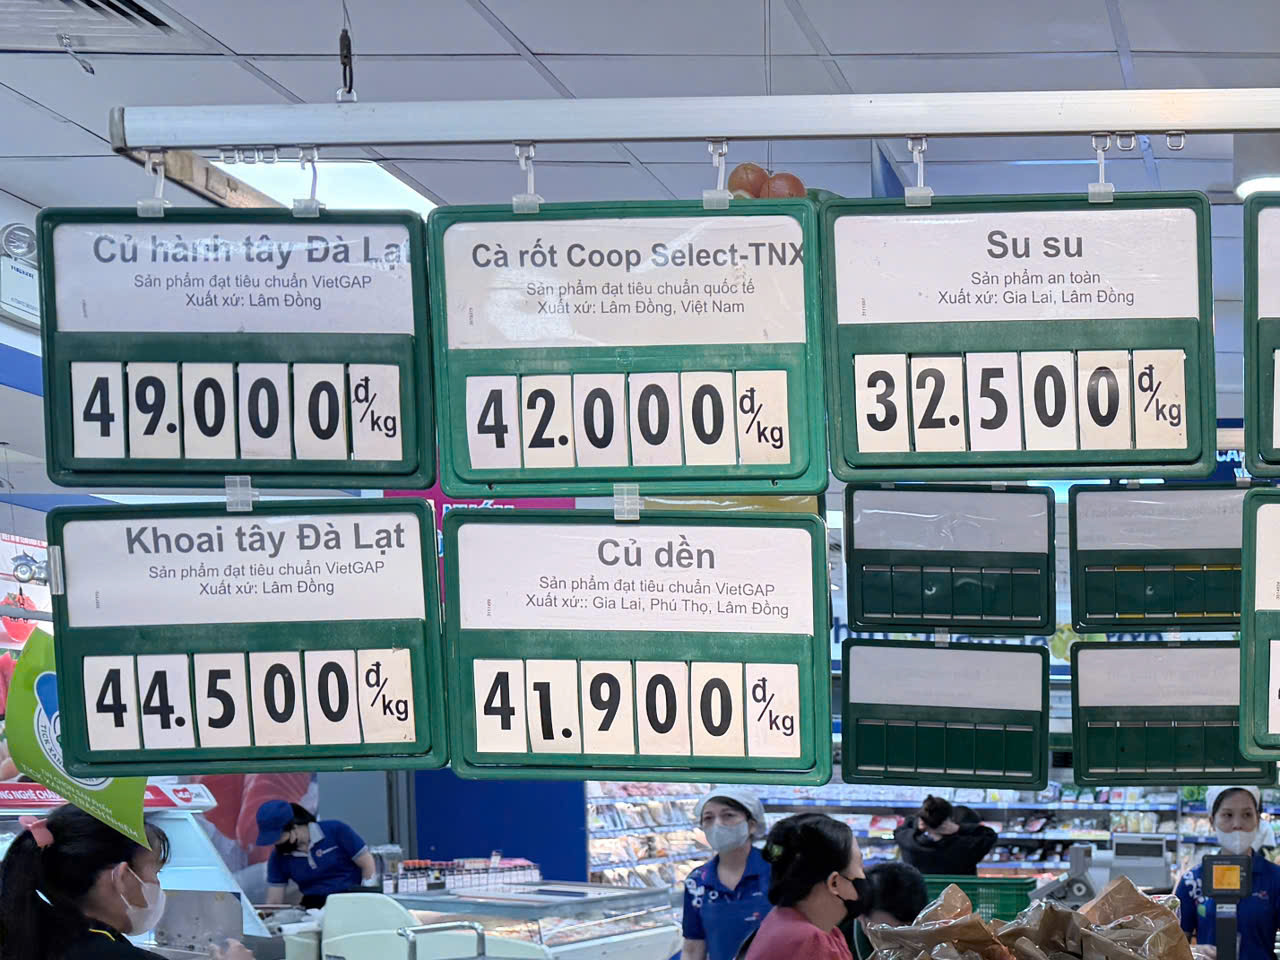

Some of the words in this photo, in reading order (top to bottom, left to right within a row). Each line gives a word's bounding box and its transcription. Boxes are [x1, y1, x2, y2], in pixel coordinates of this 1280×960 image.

[93, 234, 137, 263] Củ
[151, 235, 230, 263] hành
[244, 236, 293, 270] tây
[307, 235, 350, 264] Đà
[471, 243, 509, 268] Cà
[519, 238, 558, 268] rốt
[566, 243, 641, 272] Coop
[650, 241, 803, 268] Select-TNX
[987, 230, 1030, 258] Su
[1042, 234, 1083, 258] su
[134, 274, 162, 288] Sản
[166, 273, 205, 291] phẩm
[209, 274, 231, 290] đạt
[235, 274, 260, 288] tiêu
[264, 273, 307, 288] chuẩn
[312, 275, 372, 289] VietGAP
[526, 281, 555, 296] Sản
[558, 279, 598, 299] phẩm
[601, 281, 625, 298] đạt
[627, 281, 653, 295] tiêu
[657, 279, 700, 295] chuẩn
[703, 279, 739, 298] quốc
[742, 279, 755, 295] tế
[971, 270, 999, 286] Sản
[1003, 269, 1043, 288] phẩm
[1048, 273, 1065, 285] an
[1069, 271, 1101, 285] toàn
[186, 292, 216, 308] Xuất
[221, 294, 245, 308] xứ:
[249, 293, 279, 307] Lâm
[284, 293, 322, 310] Đồng
[537, 297, 570, 314] Xuất
[573, 299, 597, 314] xứ:
[600, 300, 631, 314] Lâm
[634, 298, 677, 317] Đồng,
[681, 298, 708, 315] Việt
[712, 300, 745, 313] Nam
[938, 287, 971, 305] Xuất
[975, 290, 999, 305] xứ:
[1002, 290, 1027, 305] Gia
[1031, 290, 1057, 307] Lai,
[1061, 289, 1092, 304] Lâm
[1096, 287, 1134, 306] Đồng
[83, 375, 340, 440] 49.000
[866, 364, 1120, 432] 32.500
[477, 384, 724, 449] 42.000
[126, 525, 223, 554] Khoai
[236, 525, 285, 558] tây
[297, 522, 341, 550] Đà
[354, 522, 405, 556] Lạt
[597, 538, 642, 567] Củ
[654, 534, 716, 569] dền
[526, 592, 558, 608] Xuất
[592, 596, 617, 610] Gia
[621, 597, 645, 613] Lai,
[650, 596, 677, 613] Phú
[682, 599, 712, 616] Thọ,
[717, 600, 748, 615] Lâm
[752, 600, 789, 618] Đồng
[96, 661, 349, 729] 44.500
[483, 671, 733, 740] 41.900
